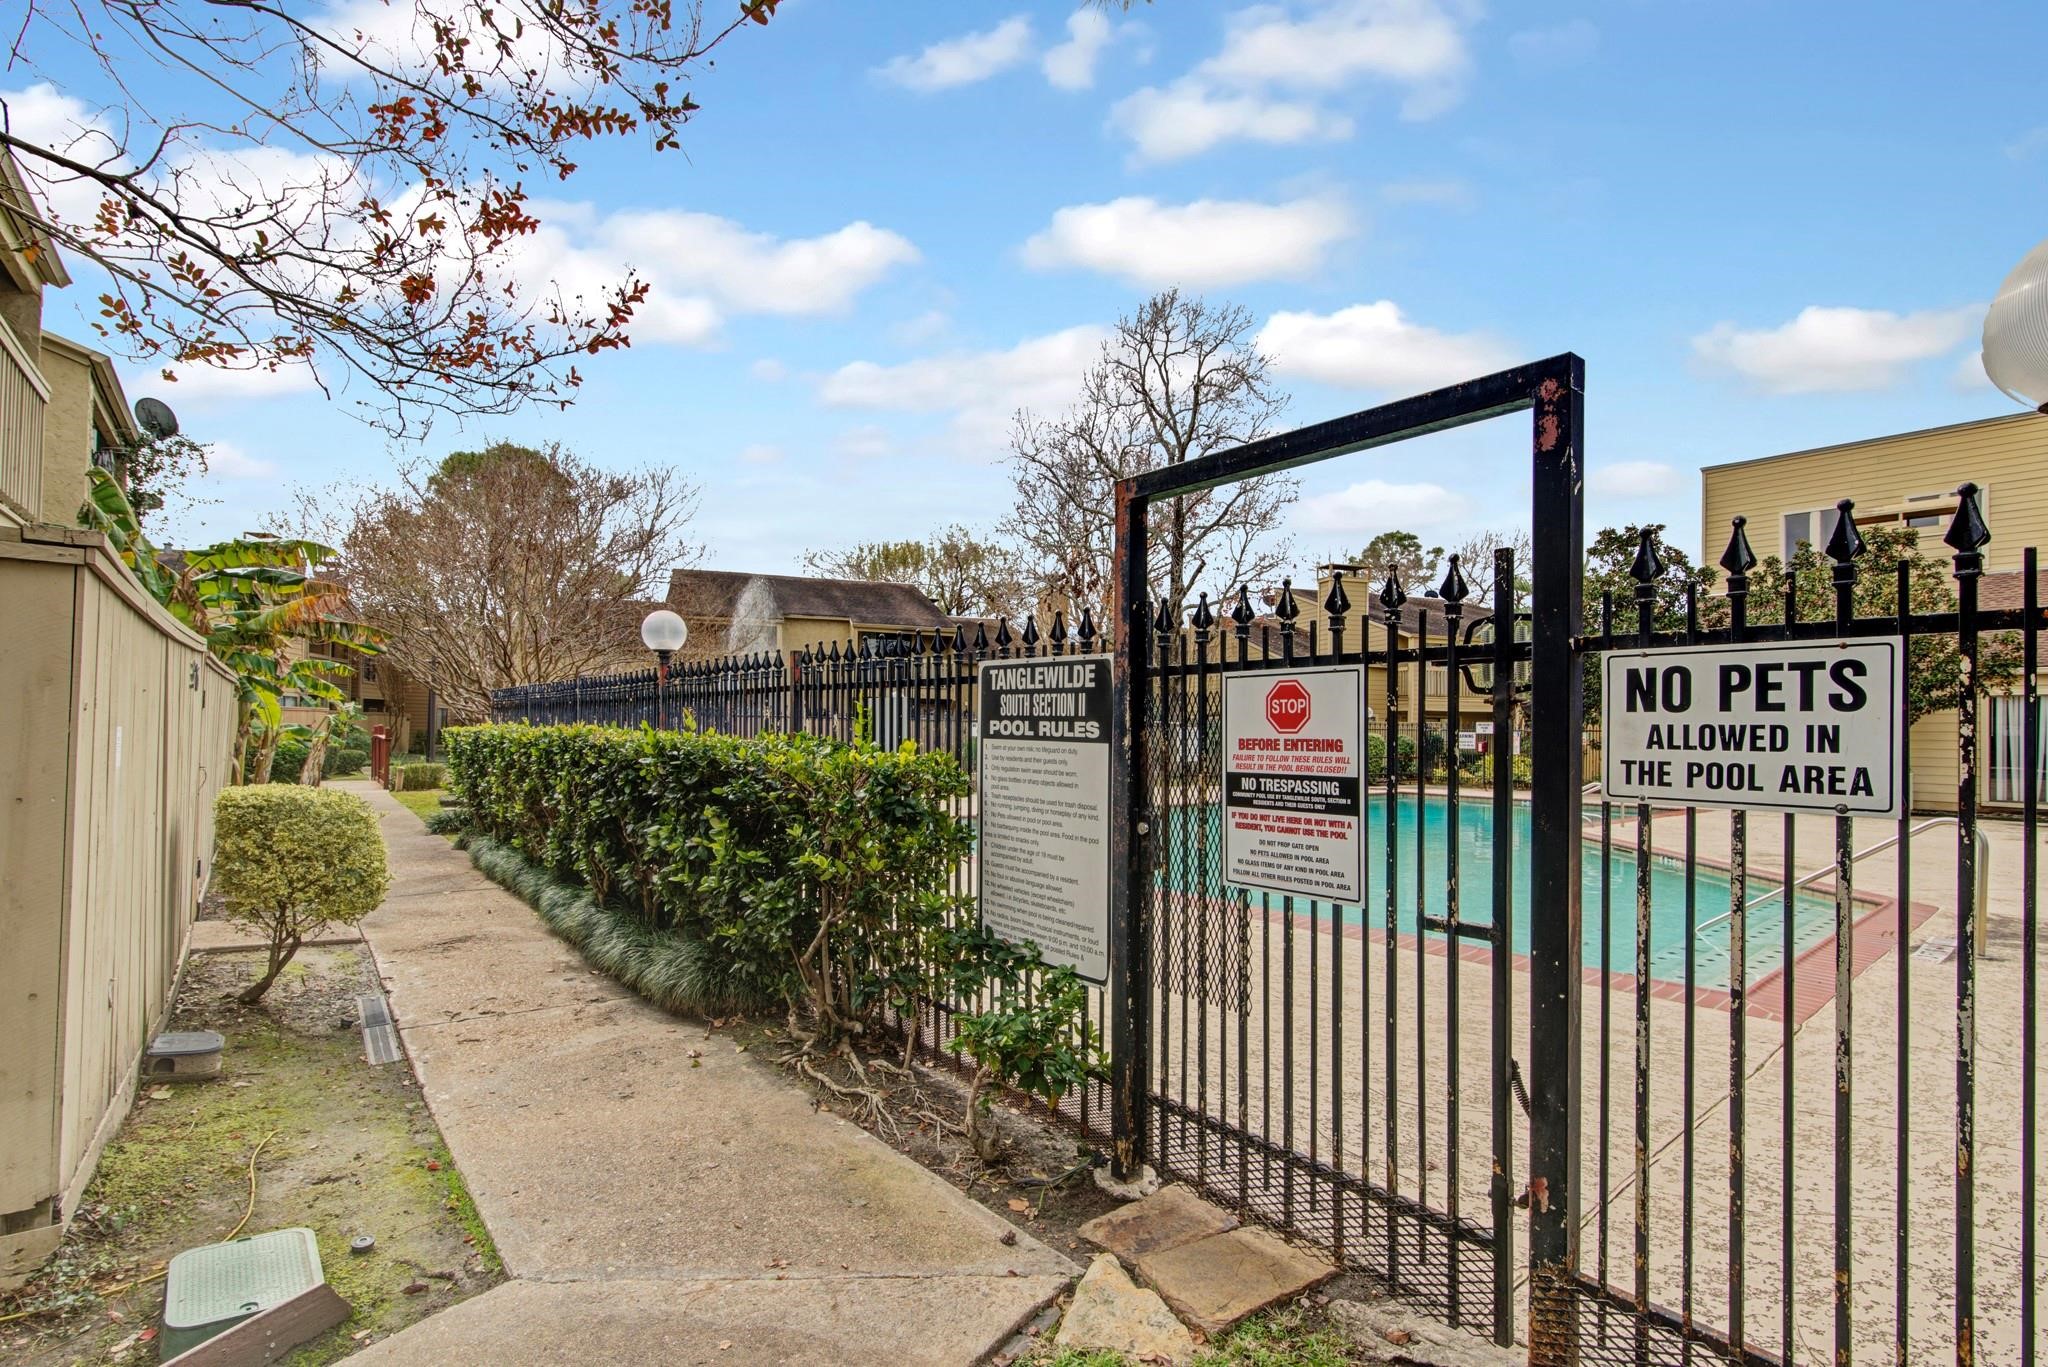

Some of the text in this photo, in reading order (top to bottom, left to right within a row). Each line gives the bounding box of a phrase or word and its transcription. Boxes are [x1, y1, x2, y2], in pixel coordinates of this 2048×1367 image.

[990, 664, 1095, 690] TANGLEWILDE
[1626, 659, 1867, 713] NO PETS
[1000, 693, 1085, 716] SOUTH SECTION II
[1272, 699, 1306, 714] STOP
[990, 720, 1100, 738] POOL RULES
[1646, 724, 1840, 753] ALLOWED IN
[1238, 738, 1343, 753] BEFORE ENTERING
[1242, 777, 1340, 796] NO TRESPASSING
[1621, 760, 1874, 796] THE POOL AREA
[1235, 822, 1347, 840] RESIDENT, YOU CANNOT USE THE POOL
[1260, 814, 1270, 822] NOT
[1272, 815, 1285, 823] LIVE
[1286, 816, 1302, 825] HERE
[1304, 818, 1312, 826] OR
[1314, 819, 1326, 827] NOT
[1328, 820, 1345, 829] WITH
[1347, 822, 1352, 830] A
[1270, 852, 1293, 860] ALLOWED
[1233, 868, 1250, 876] FOLLOW
[1277, 874, 1292, 883] RULES
[1294, 877, 1313, 886] POSTED
[1321, 881, 1334, 889] POOL
[1336, 883, 1350, 891] AREA
